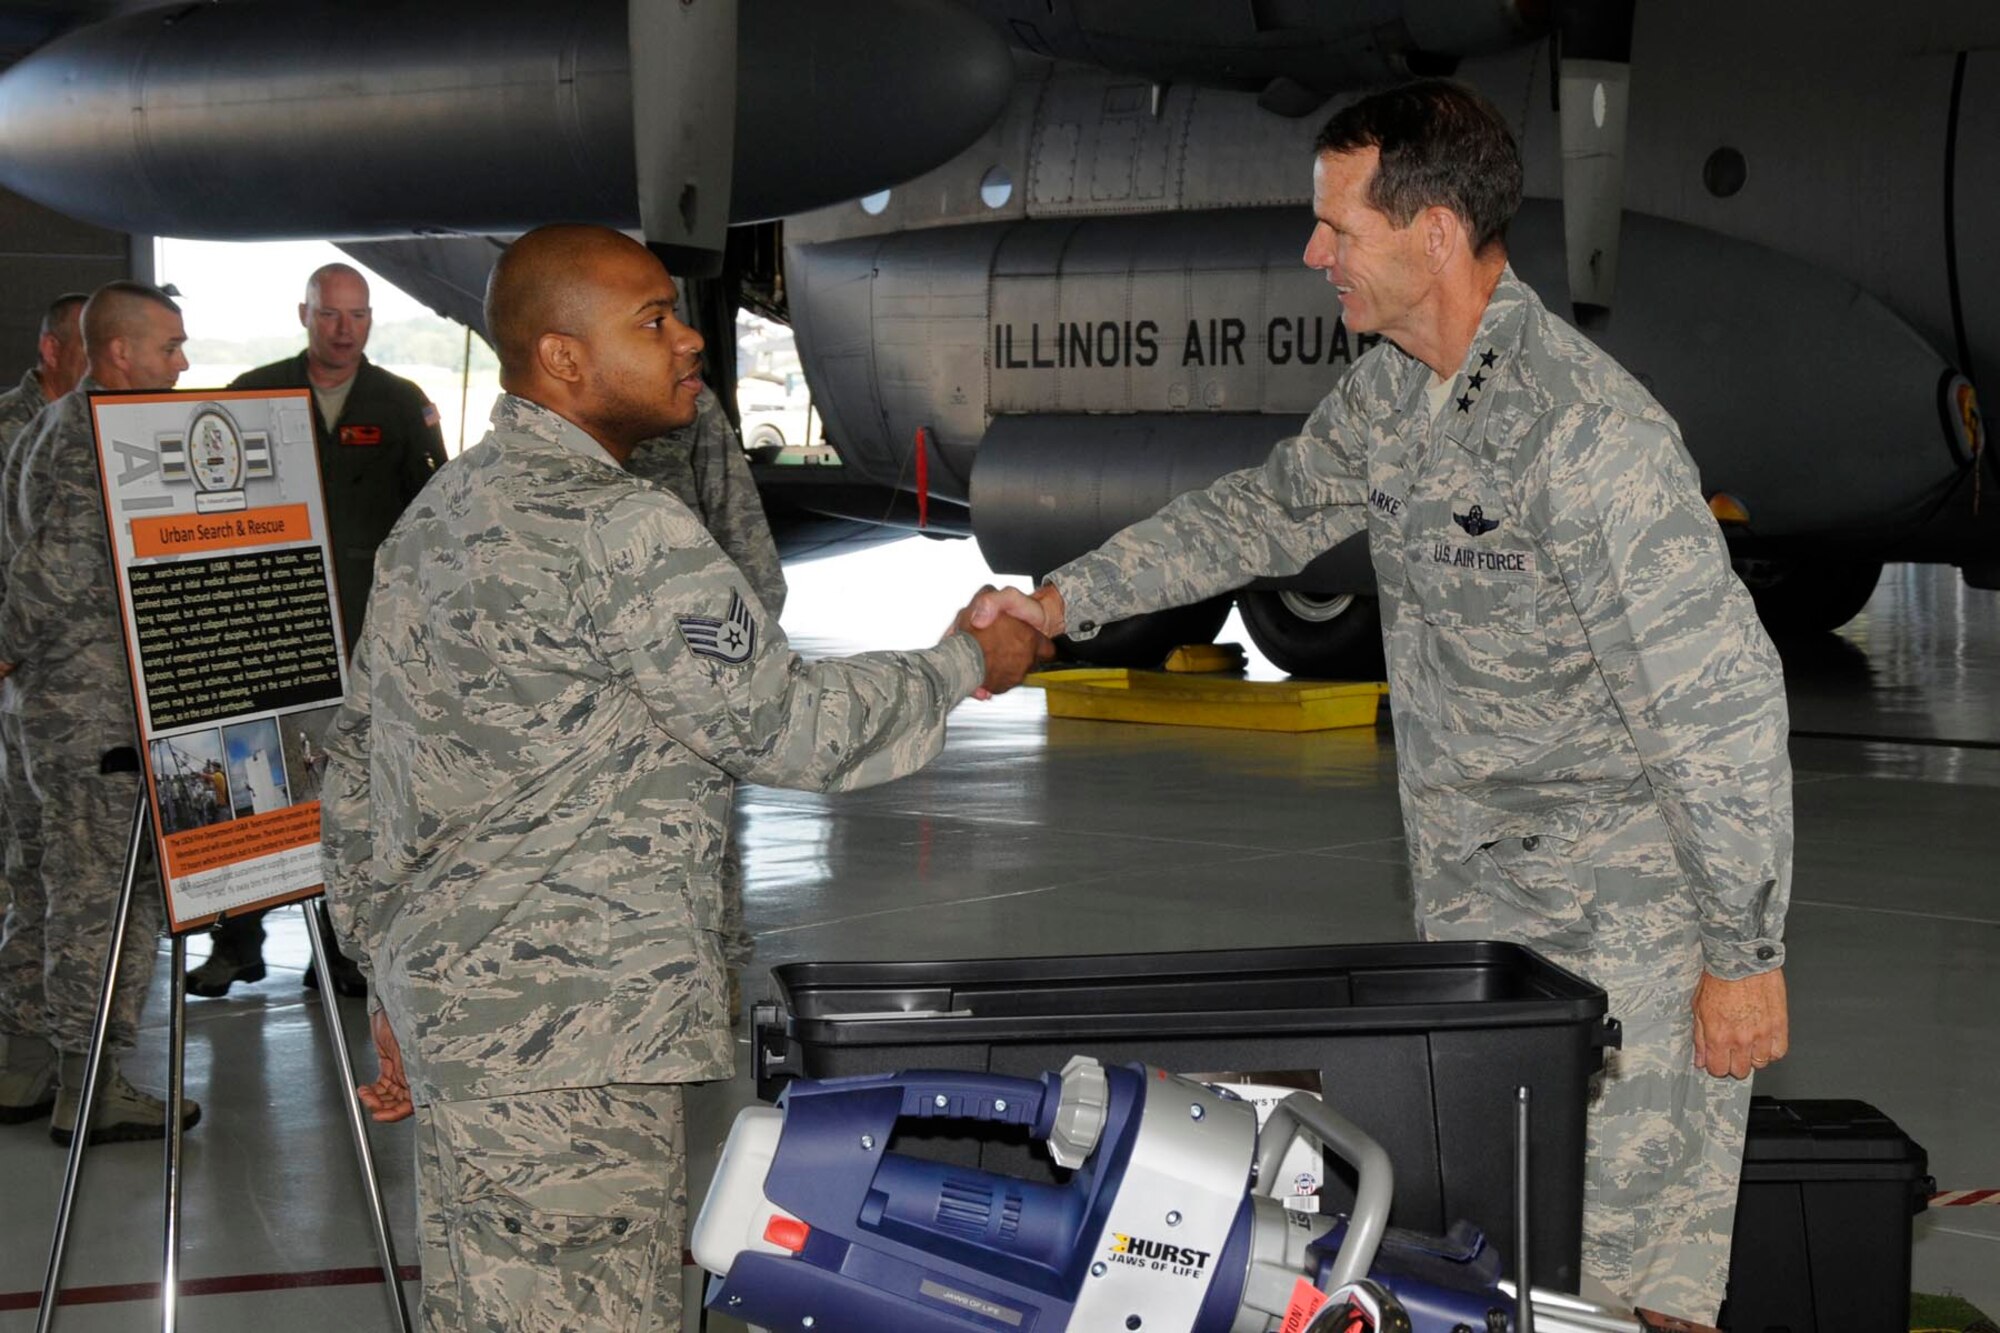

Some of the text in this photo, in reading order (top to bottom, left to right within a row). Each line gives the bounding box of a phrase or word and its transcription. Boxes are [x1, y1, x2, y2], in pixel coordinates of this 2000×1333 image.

[995, 320, 1159, 369] ILLINOIS
[1182, 318, 1245, 367] AIR
[1368, 488, 1402, 516] ARKE
[159, 517, 285, 545] Urban Search & Rescue
[1433, 543, 1526, 572] U.S. AIR FORCE
[1107, 1253, 1201, 1279] JAWS OF LIFE
[1127, 1237, 1211, 1269] HURST
[942, 1292, 1000, 1315] JAWS OF LIFE
